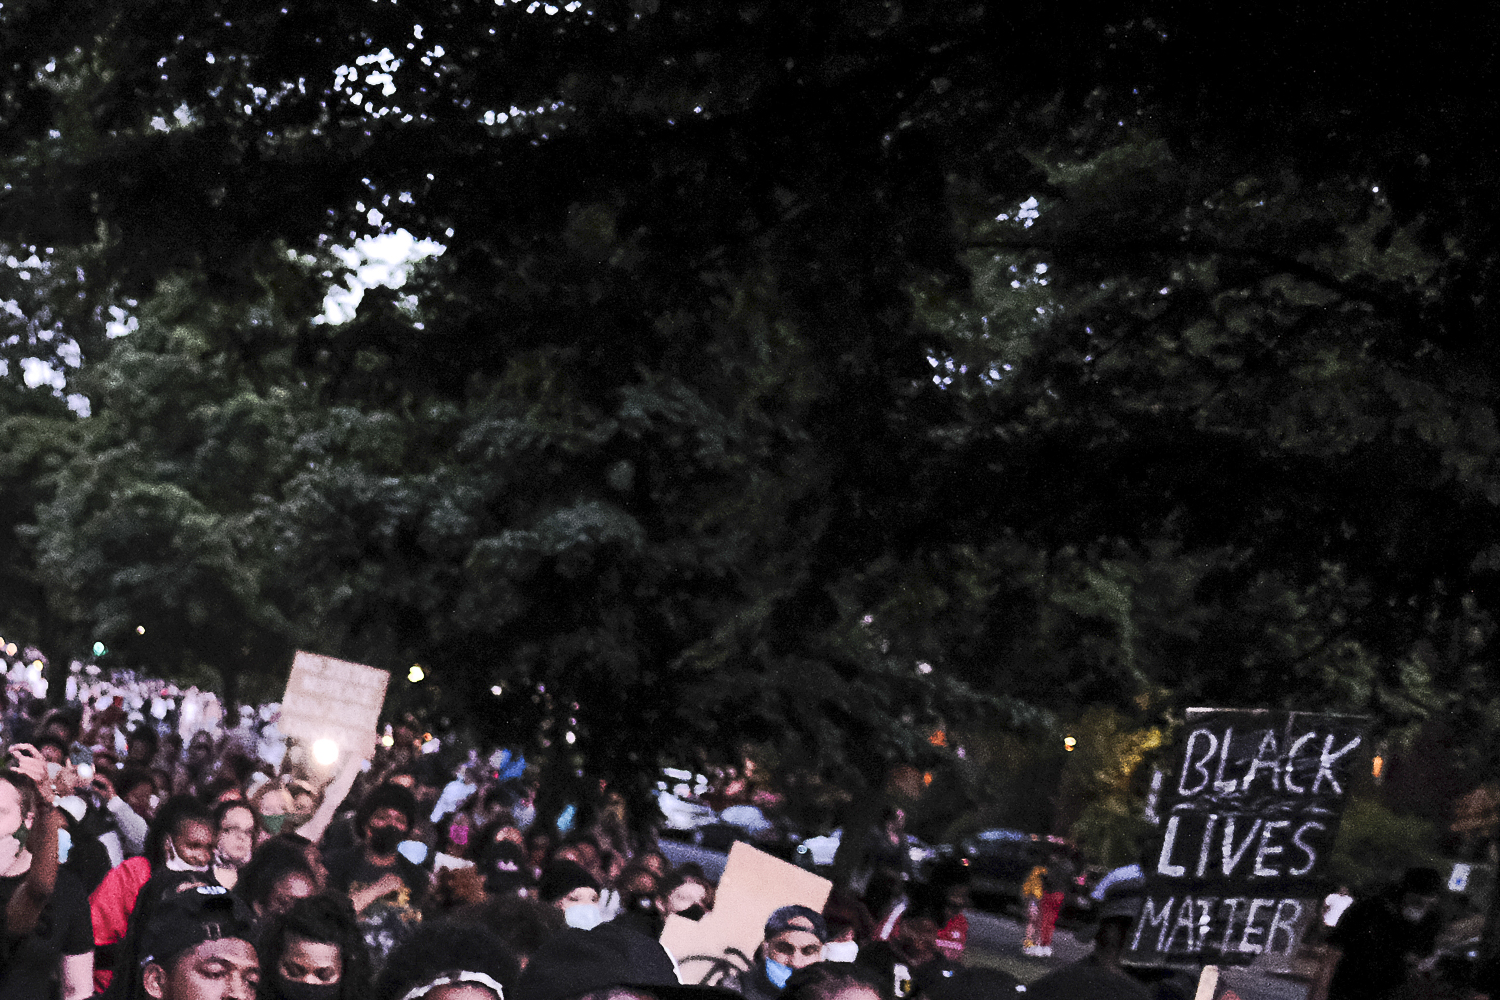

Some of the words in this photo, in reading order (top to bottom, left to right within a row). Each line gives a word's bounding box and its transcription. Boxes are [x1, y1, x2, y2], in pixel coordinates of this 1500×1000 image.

[1179, 725, 1362, 797] BLACK
[1157, 814, 1326, 878] LIVES
[1130, 895, 1302, 956] MATTER
